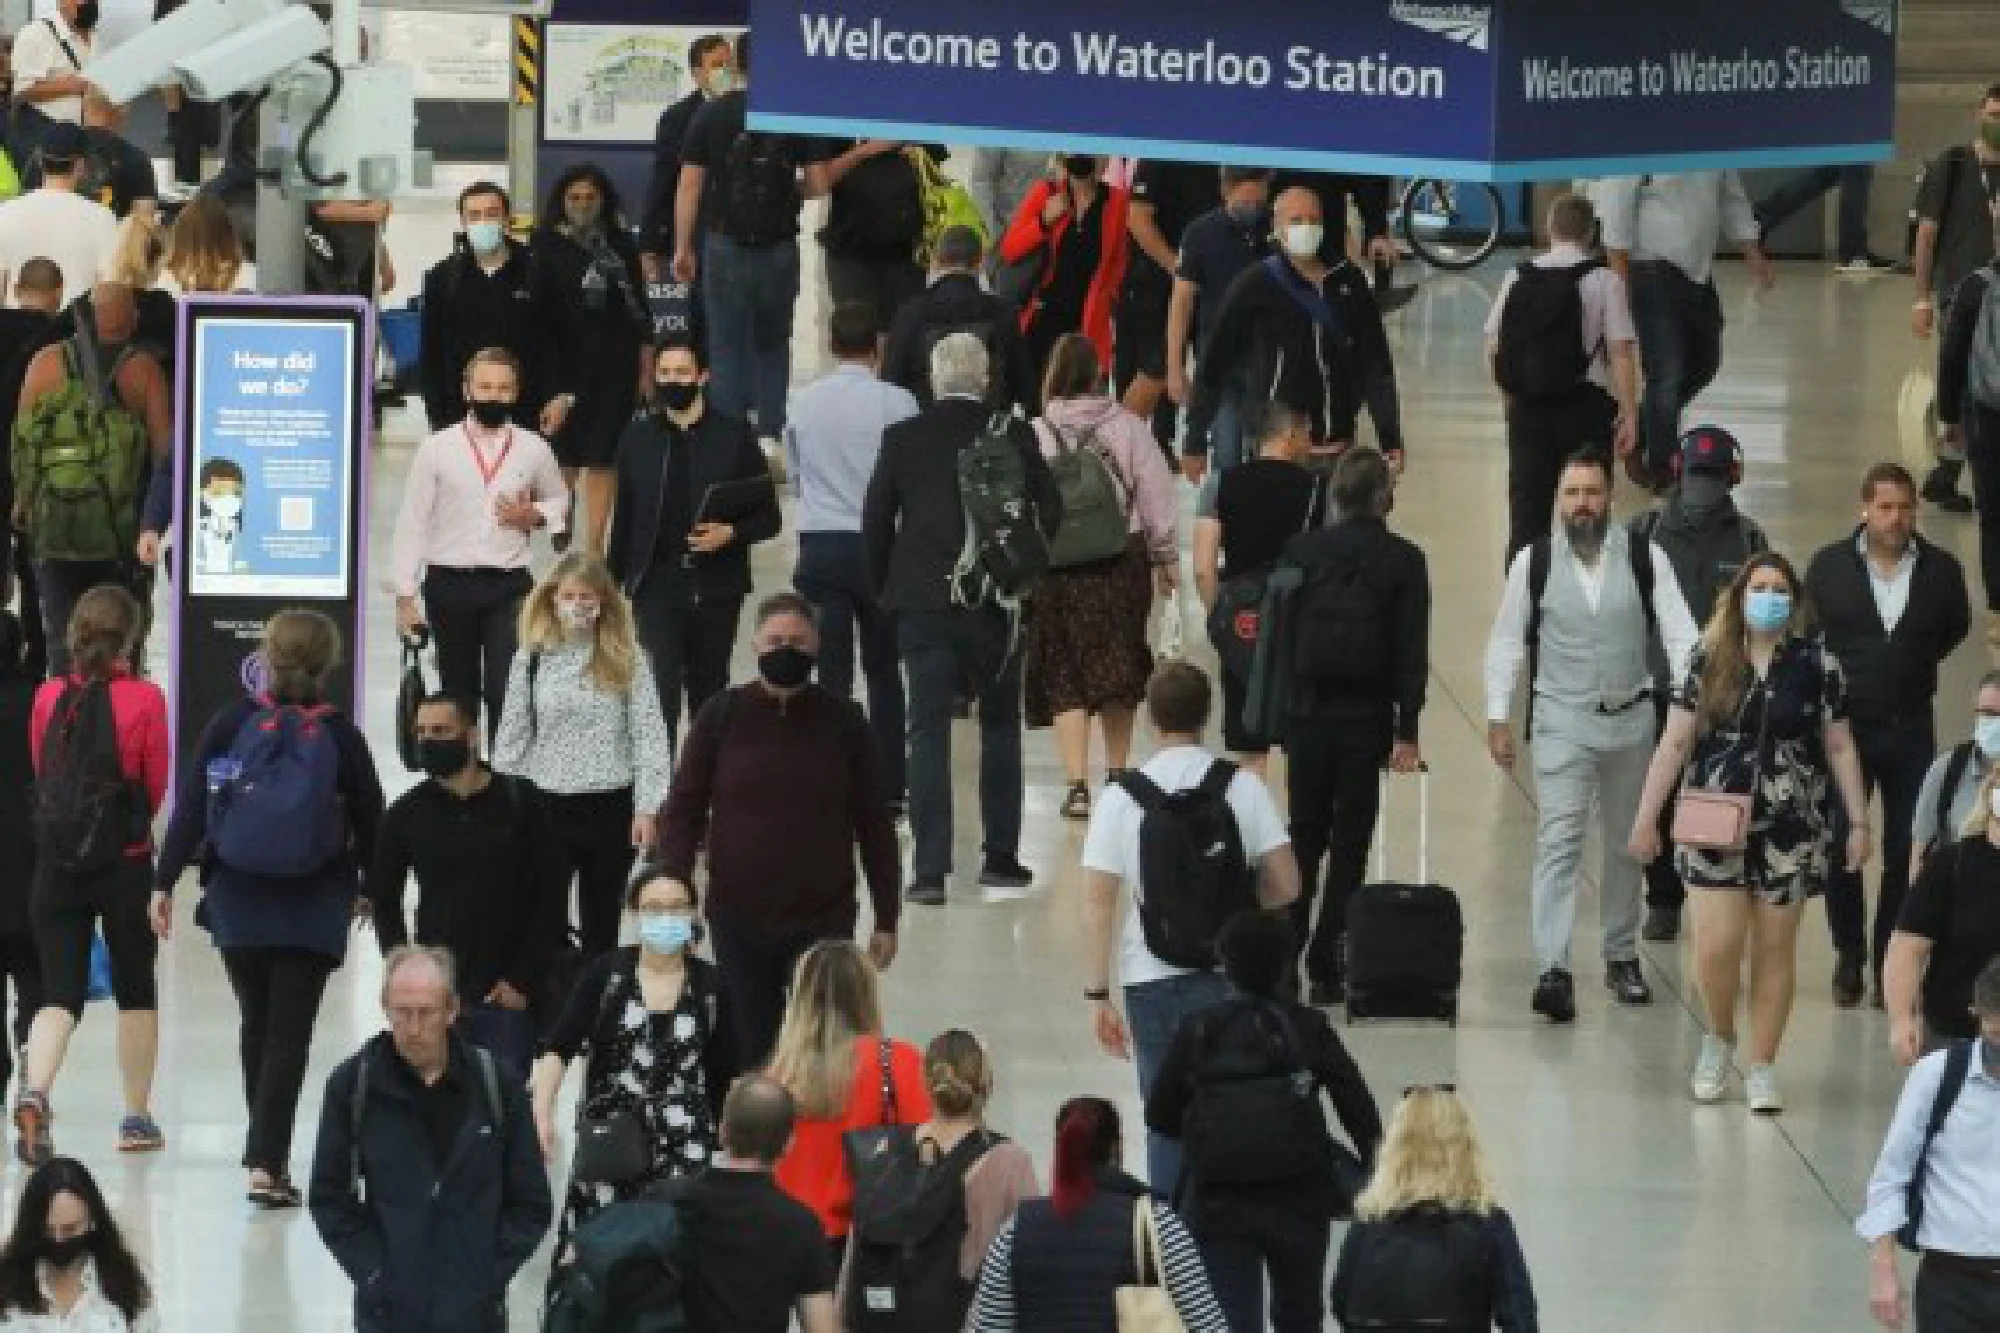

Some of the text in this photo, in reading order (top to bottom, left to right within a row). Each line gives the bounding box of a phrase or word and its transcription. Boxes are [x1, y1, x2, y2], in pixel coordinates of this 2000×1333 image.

[800, 13, 1444, 99] Welcome to Waterloo Station
[1522, 46, 1871, 101] Welcome to Waterloo Station
[234, 350, 317, 372] How did
[239, 375, 310, 396] we do?
